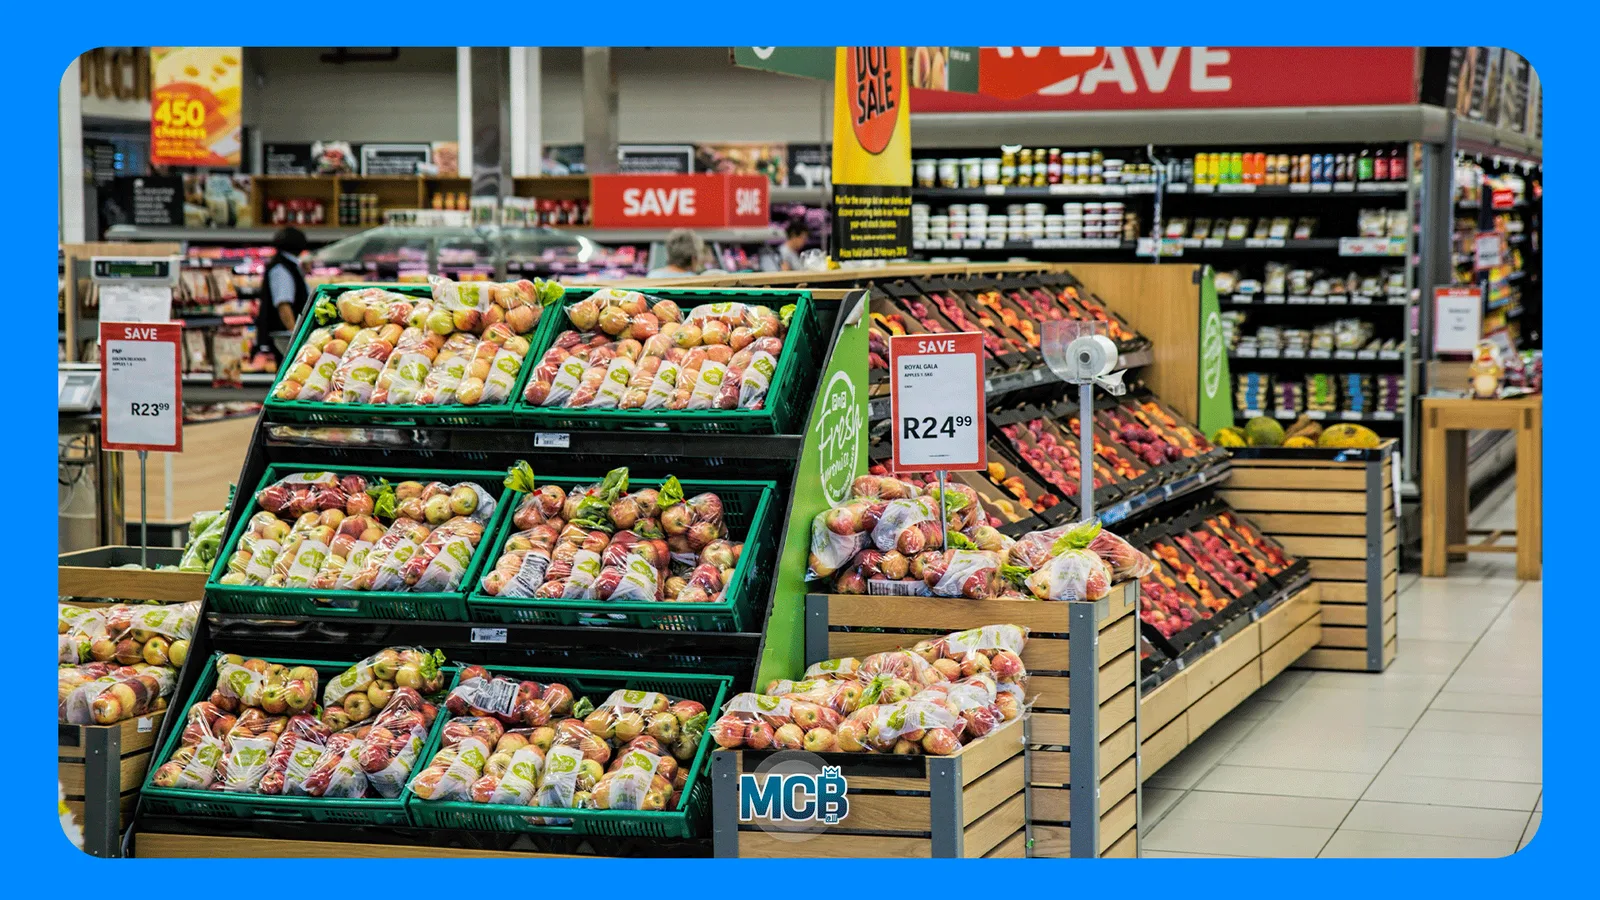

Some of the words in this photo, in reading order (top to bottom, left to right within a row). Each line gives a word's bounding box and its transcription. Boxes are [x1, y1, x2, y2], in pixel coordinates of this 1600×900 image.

[1037, 46, 1233, 96] AVE
[857, 70, 895, 125] SALE
[154, 99, 205, 127] 450
[622, 187, 697, 217] SAVE
[735, 187, 761, 217] SAVE
[124, 327, 157, 340] SAVE
[918, 340, 956, 353] SAVE
[815, 385, 863, 461] Fresh
